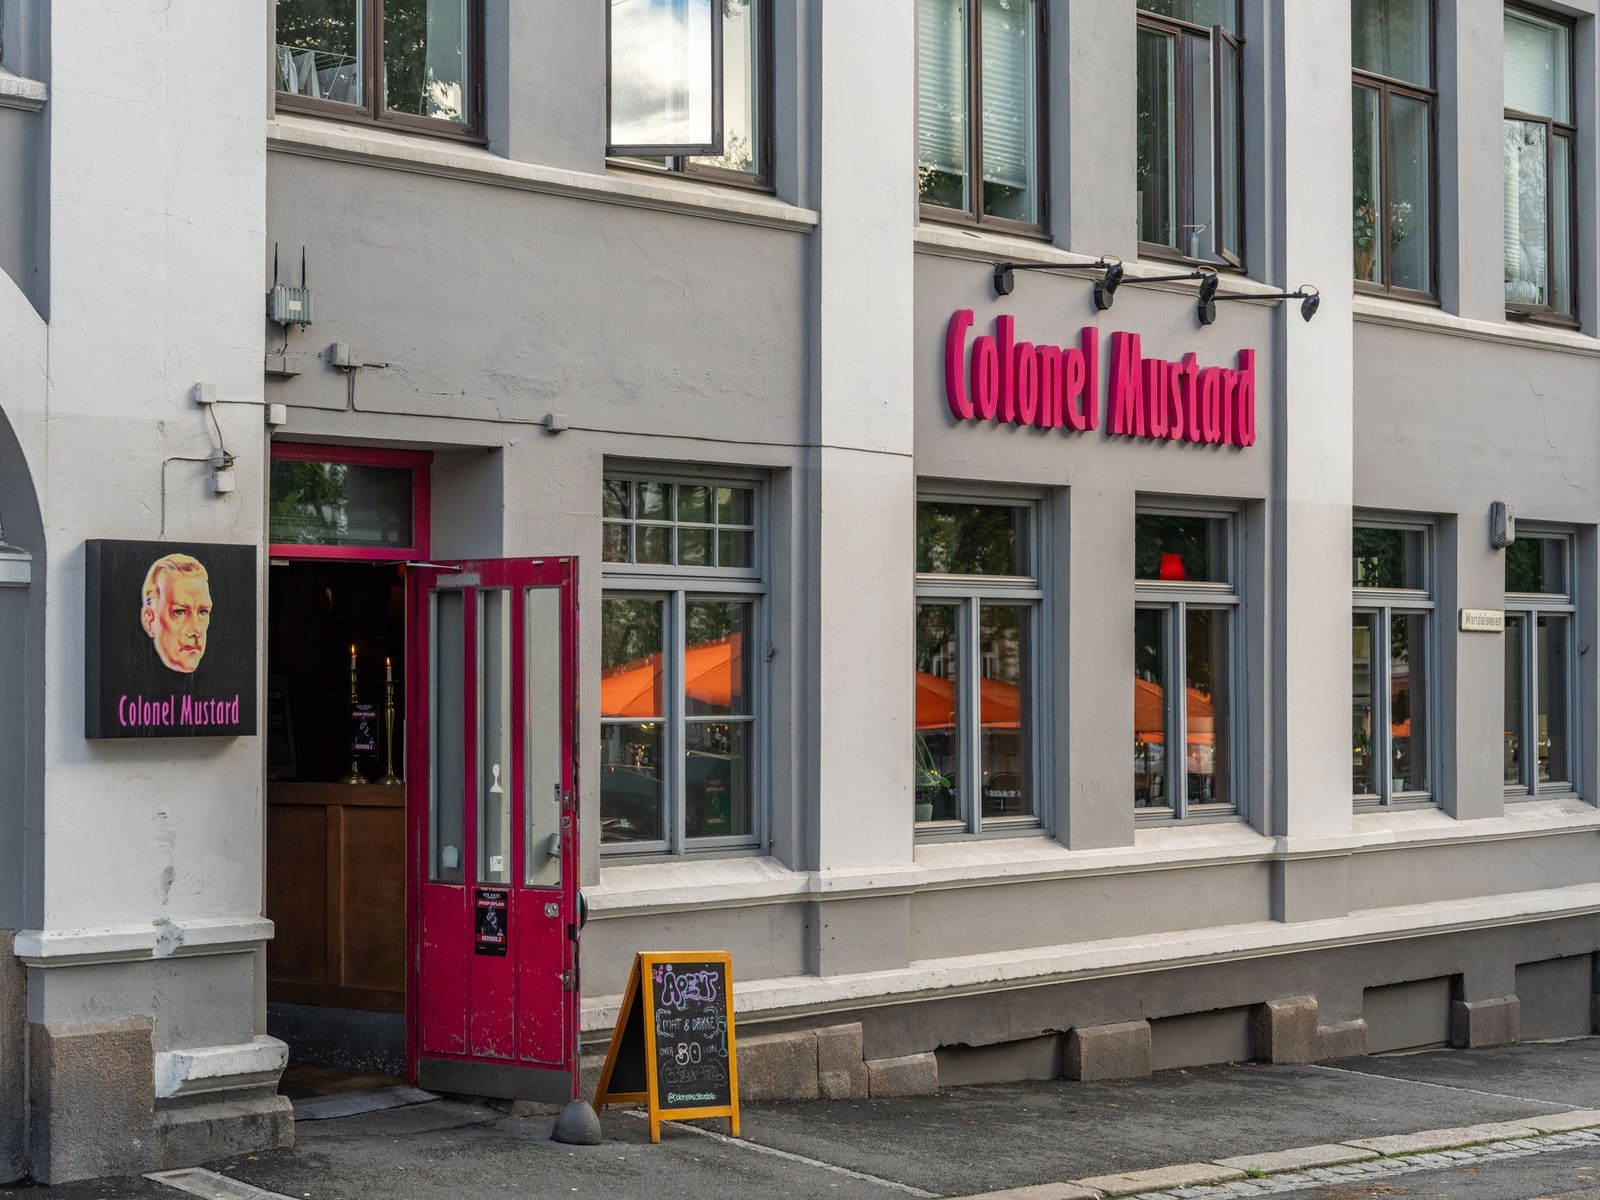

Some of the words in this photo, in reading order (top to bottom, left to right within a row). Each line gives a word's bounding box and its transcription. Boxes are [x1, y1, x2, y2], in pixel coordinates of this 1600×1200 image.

[945, 308, 1099, 431] Colonel
[1106, 331, 1256, 447] Mustard
[1465, 612, 1502, 626] Maridalsveien
[119, 694, 175, 726] Colonel
[180, 694, 239, 725] Mustard
[662, 1018, 682, 1031] MAT
[683, 1019, 690, 1032] &
